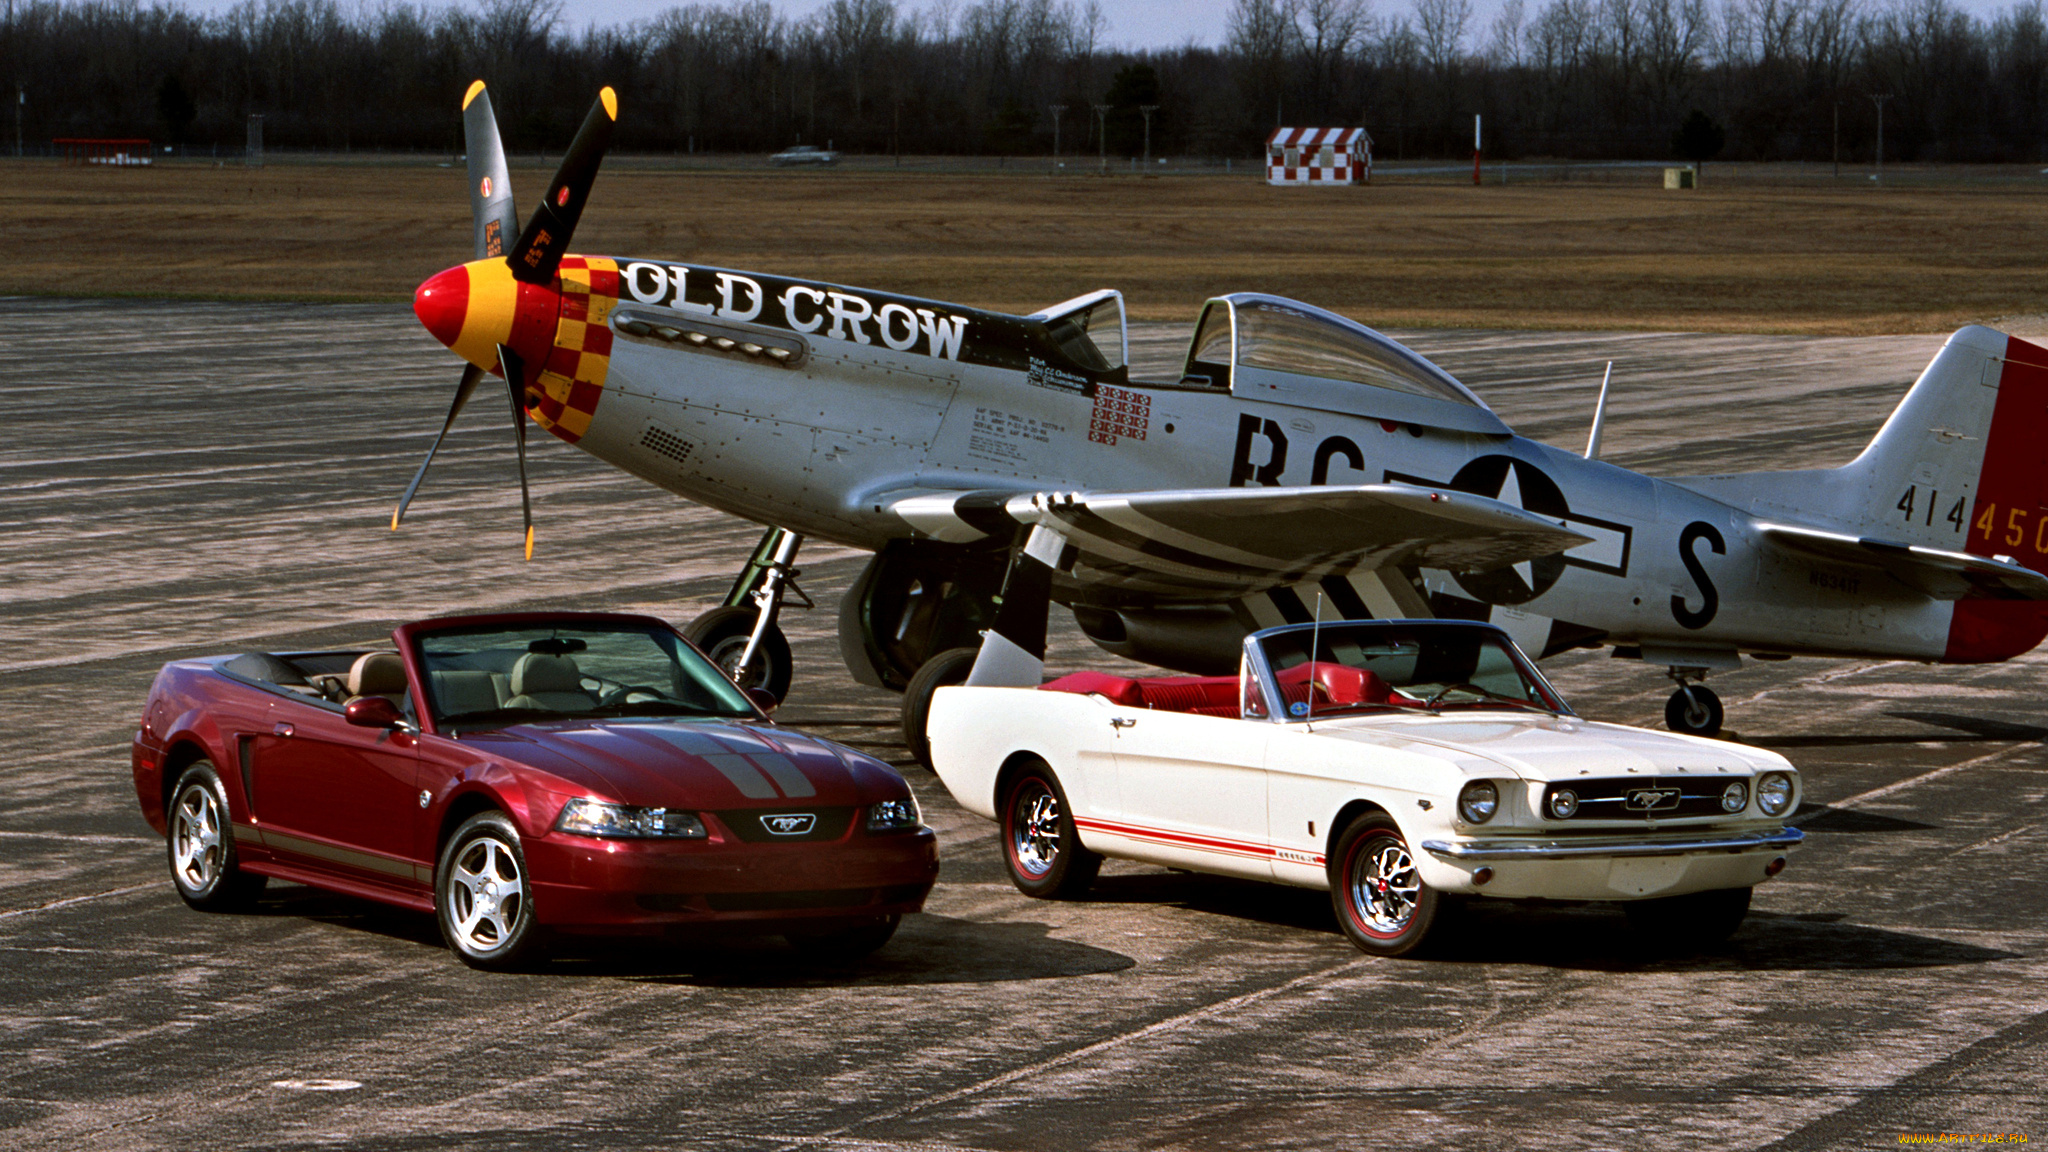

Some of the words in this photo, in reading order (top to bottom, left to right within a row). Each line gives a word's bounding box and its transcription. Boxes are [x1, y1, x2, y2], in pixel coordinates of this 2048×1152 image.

[619, 262, 763, 322] OLD
[777, 285, 970, 361] CROW
[1670, 521, 1727, 630] S
